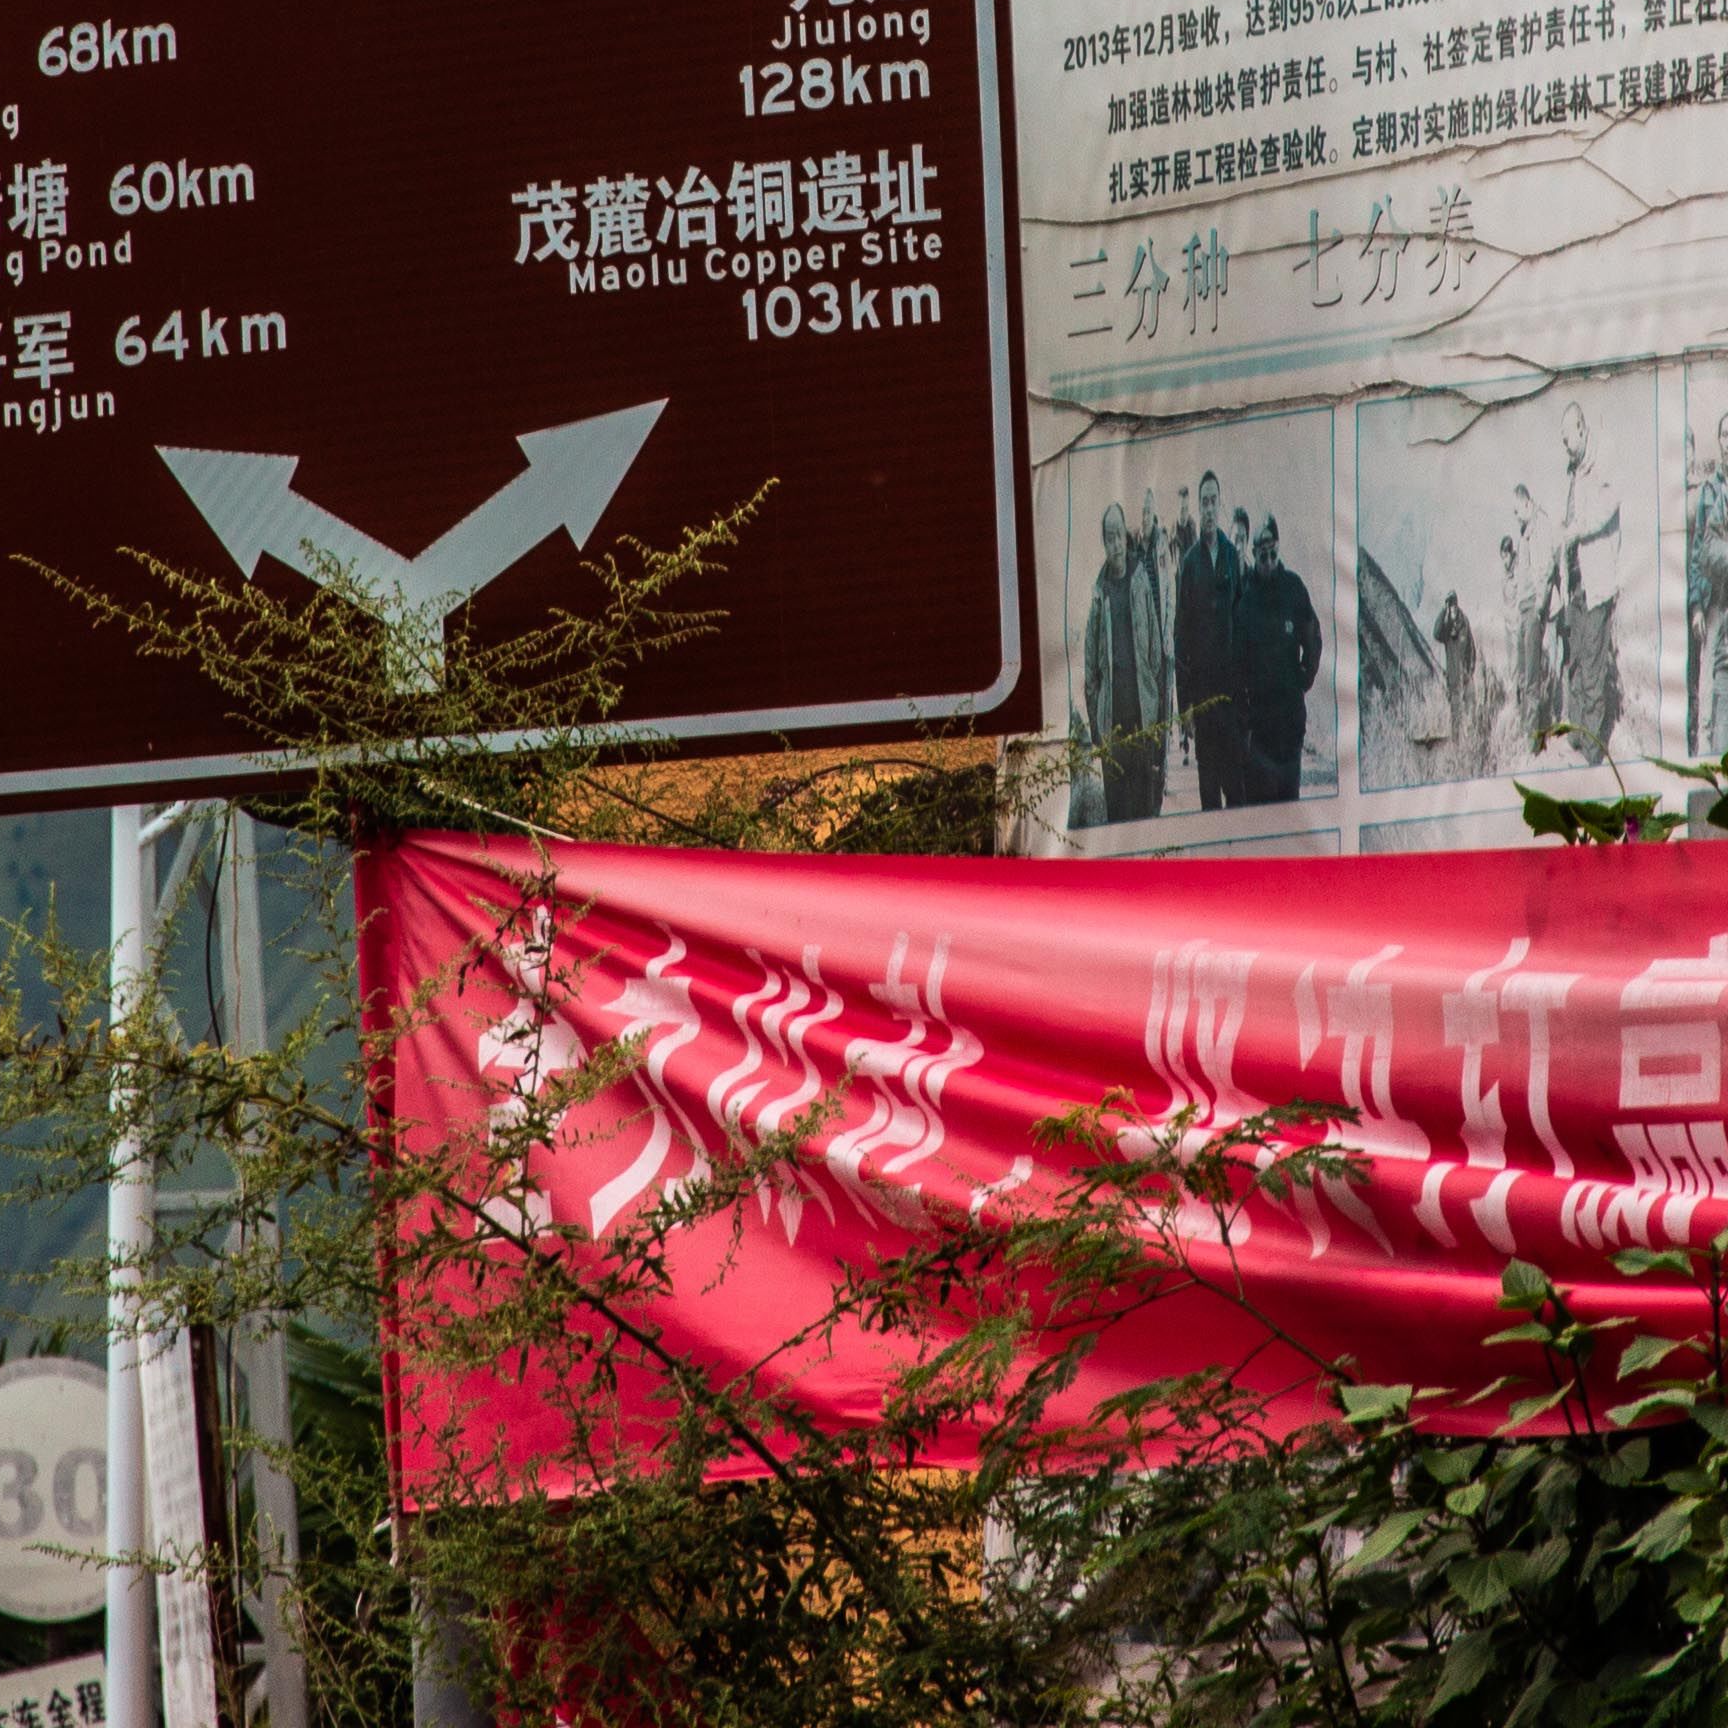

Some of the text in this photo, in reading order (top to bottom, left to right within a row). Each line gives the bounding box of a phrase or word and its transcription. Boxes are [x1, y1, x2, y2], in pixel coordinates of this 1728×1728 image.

[39, 19, 176, 76] 68km
[772, 9, 929, 49] Jiulong
[740, 55, 930, 116] 128km
[110, 159, 254, 214] 60km
[512, 144, 941, 264] 茂麓冶铜遗址
[41, 231, 131, 271] Pond
[570, 229, 942, 293] Maolu Copper Site
[1068, 183, 1476, 343] 三分种 七分养
[116, 309, 286, 365] 64km
[743, 279, 940, 340] 103km
